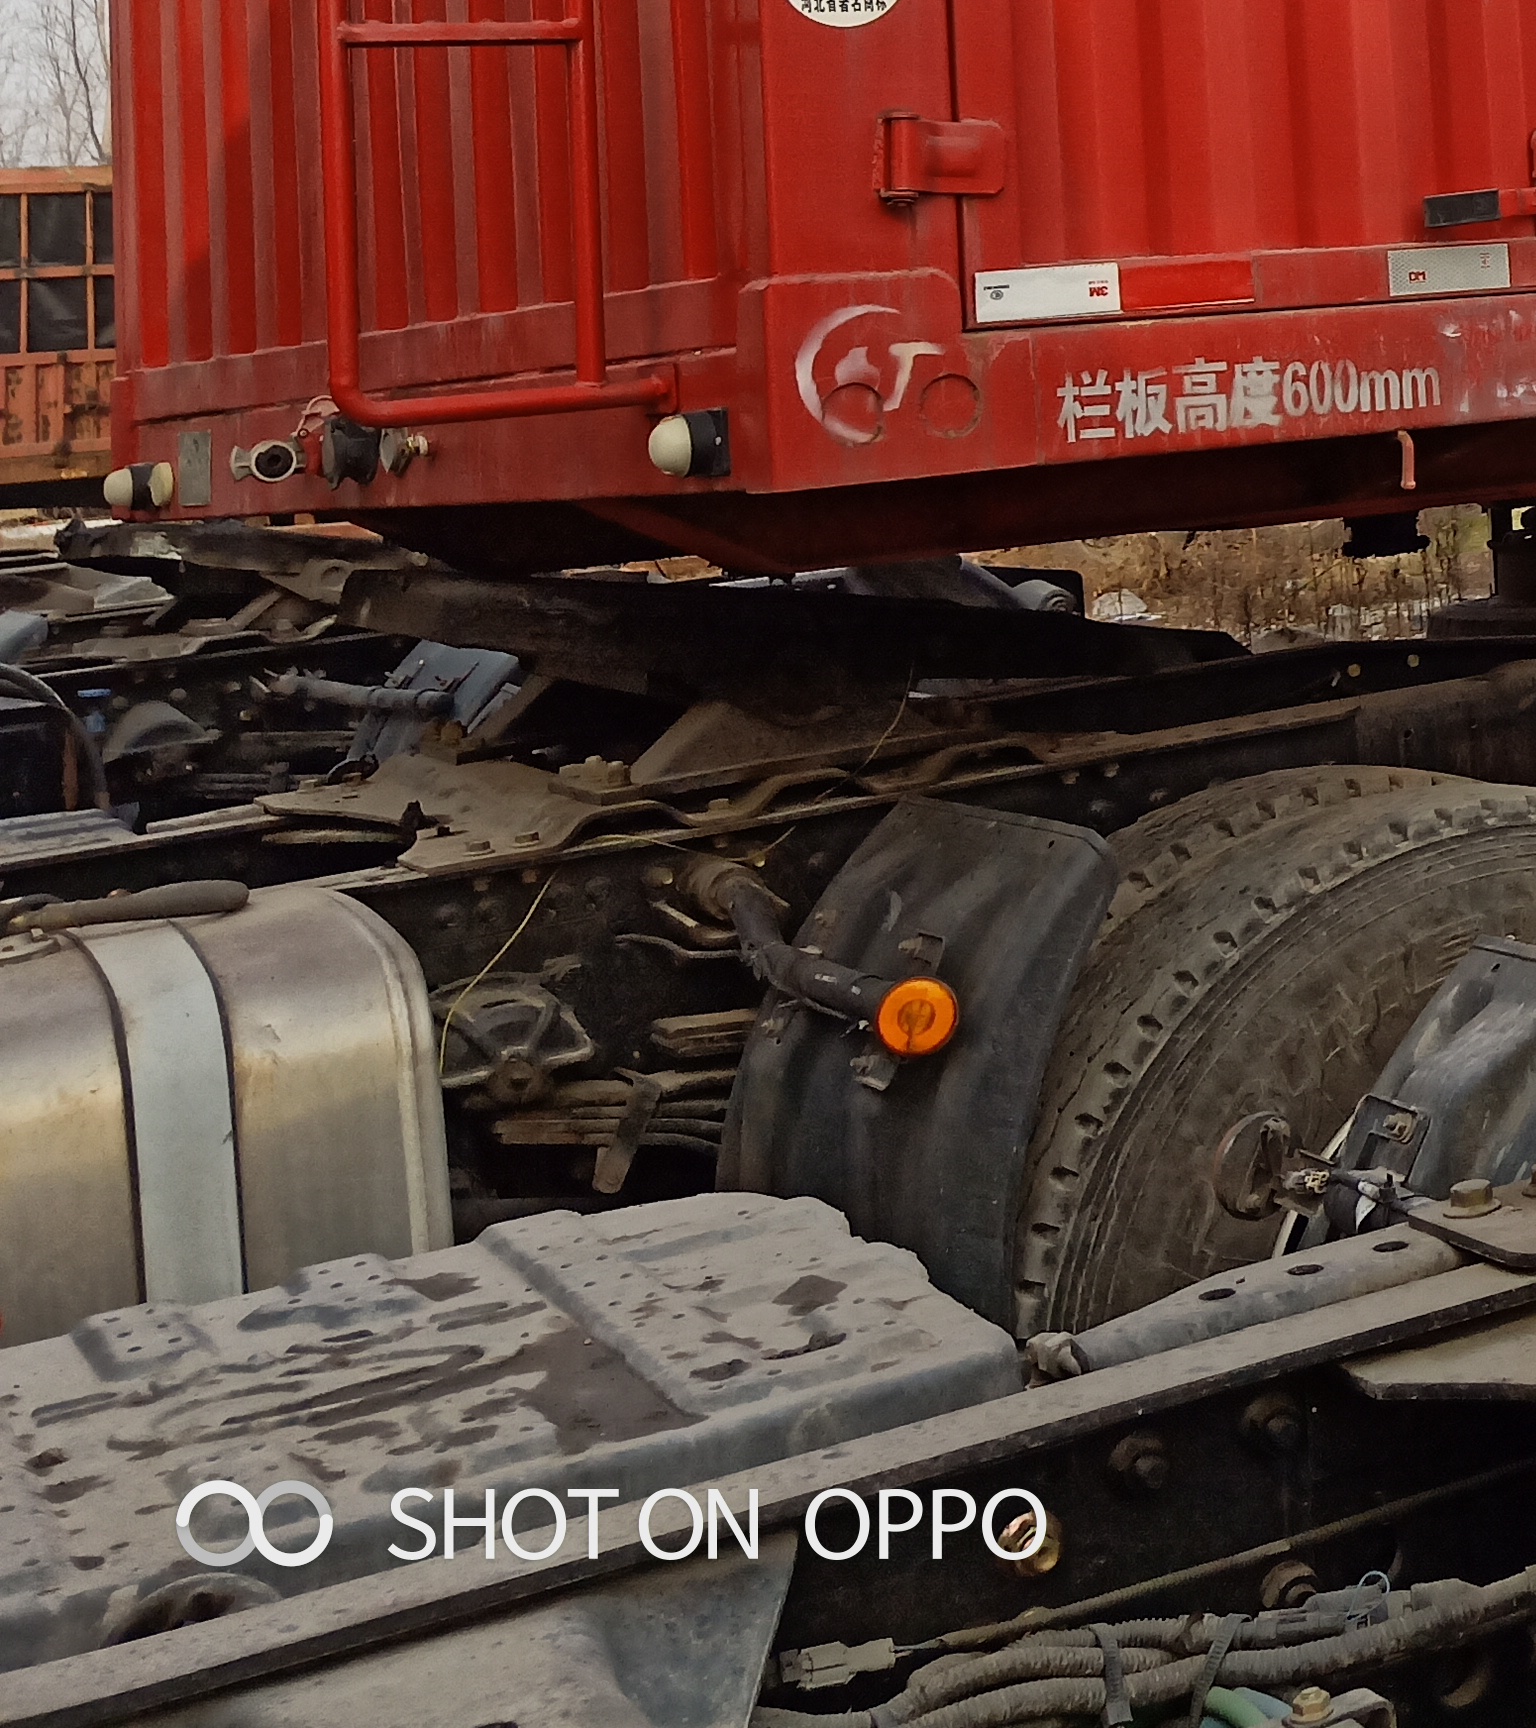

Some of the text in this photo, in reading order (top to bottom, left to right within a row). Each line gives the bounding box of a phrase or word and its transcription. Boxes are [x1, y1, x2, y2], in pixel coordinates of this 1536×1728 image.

[1088, 285, 1109, 298] 3M
[1056, 356, 1442, 443] 栏板高度600mm
